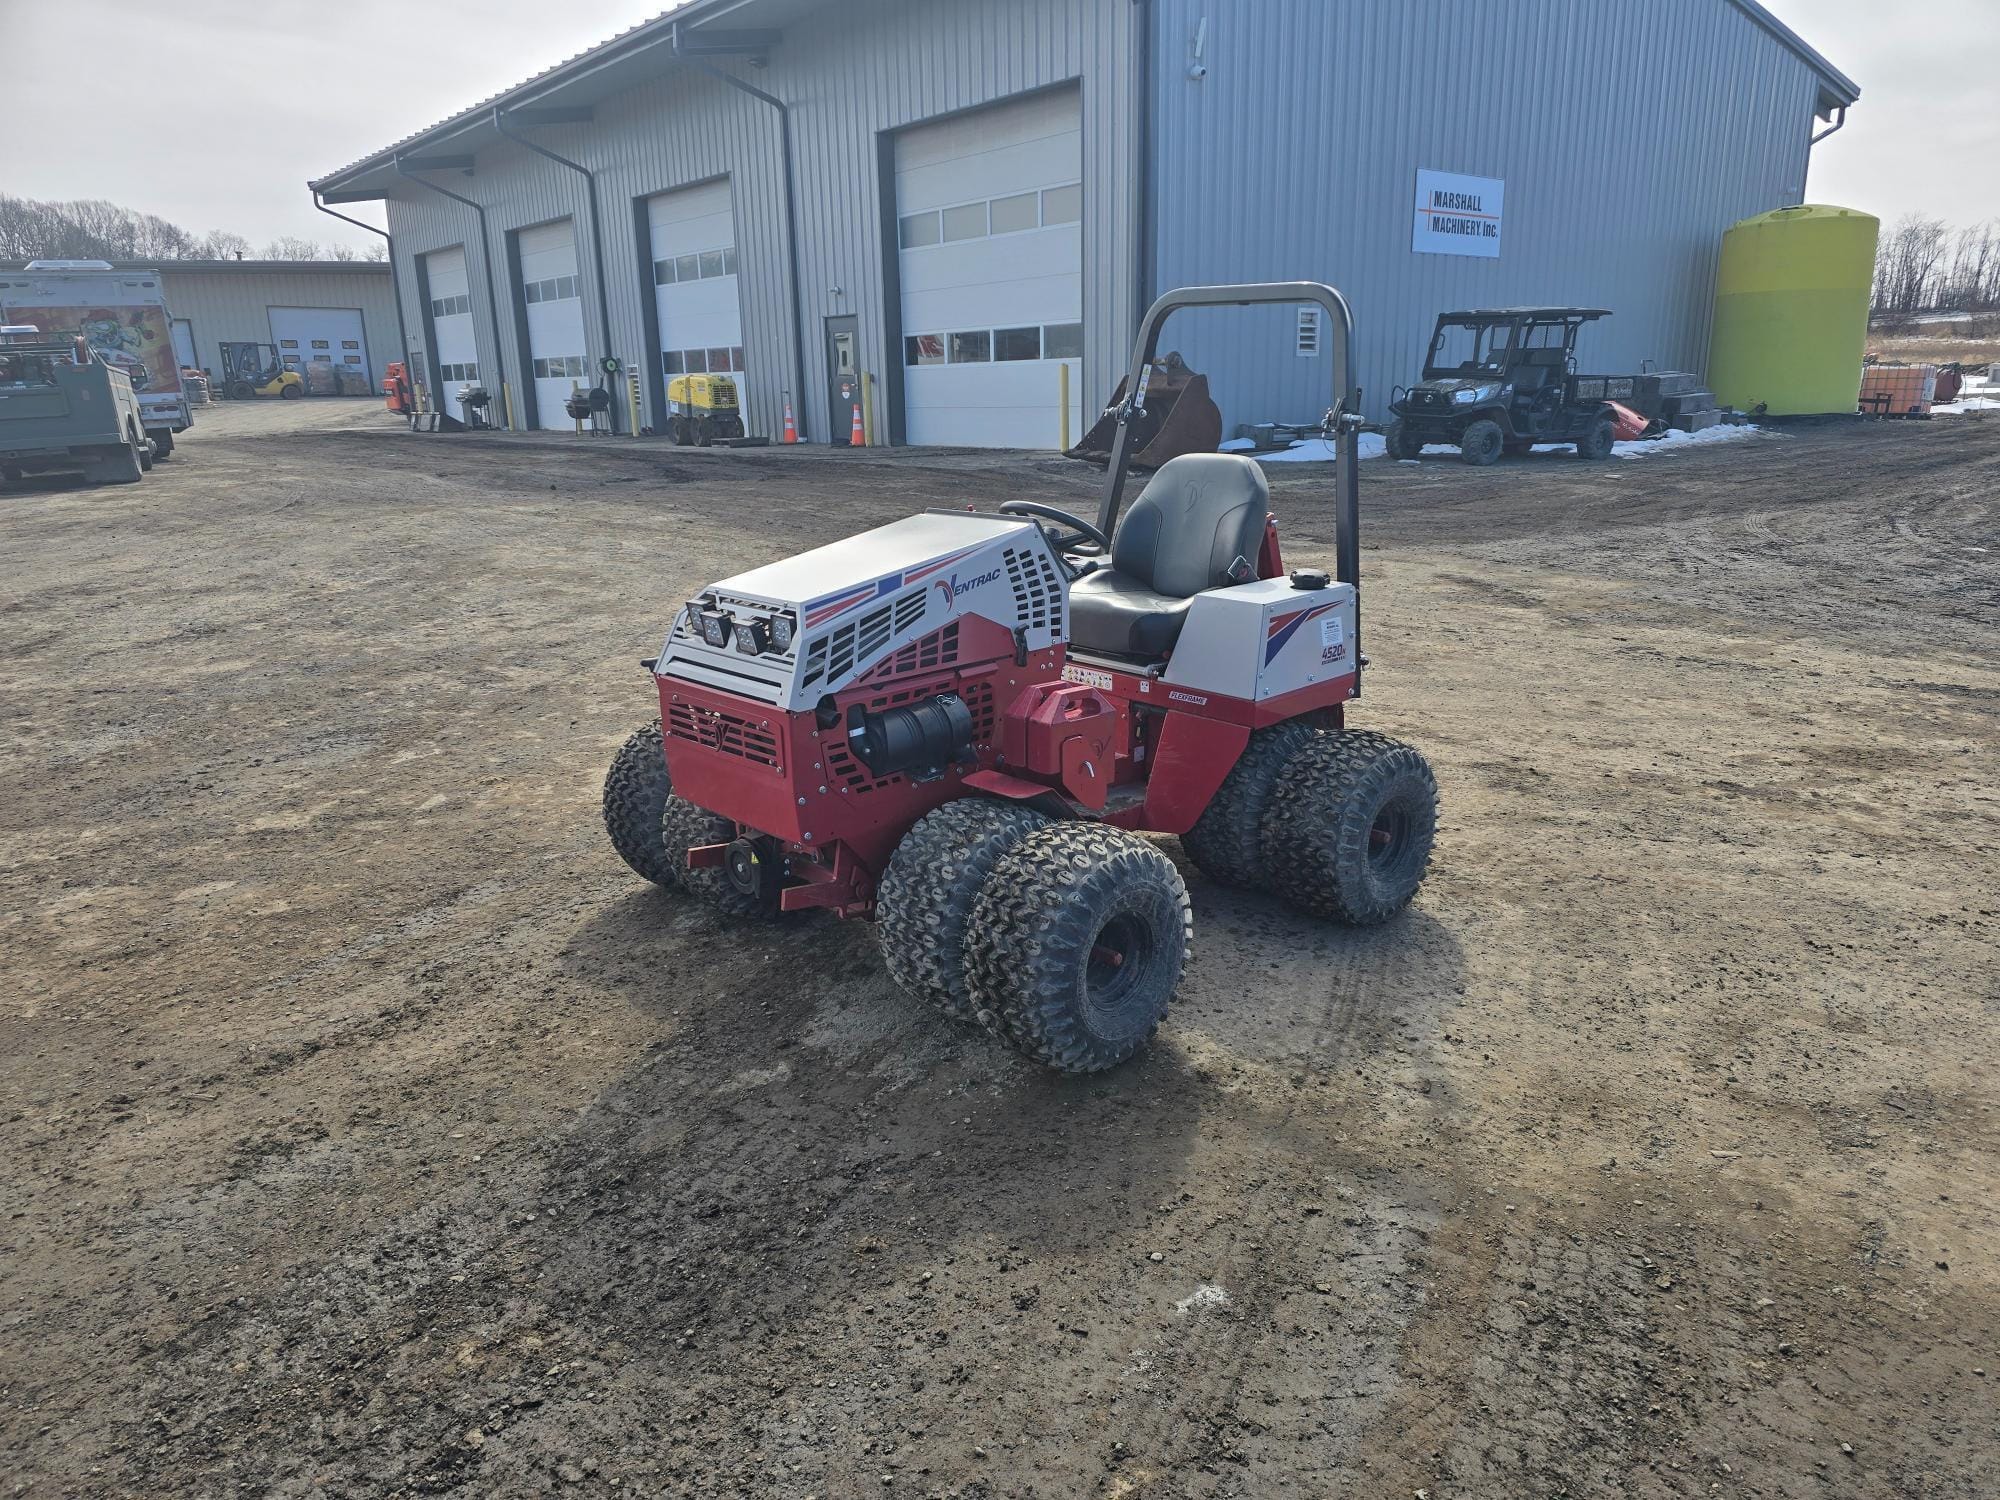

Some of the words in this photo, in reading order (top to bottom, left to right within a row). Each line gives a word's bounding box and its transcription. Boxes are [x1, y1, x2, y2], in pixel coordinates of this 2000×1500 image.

[1433, 190, 1482, 212] MARSHALL
[1432, 216, 1481, 236] MACHINERY
[1483, 221, 1498, 238] Inc.
[935, 568, 1001, 614] VENTRAC
